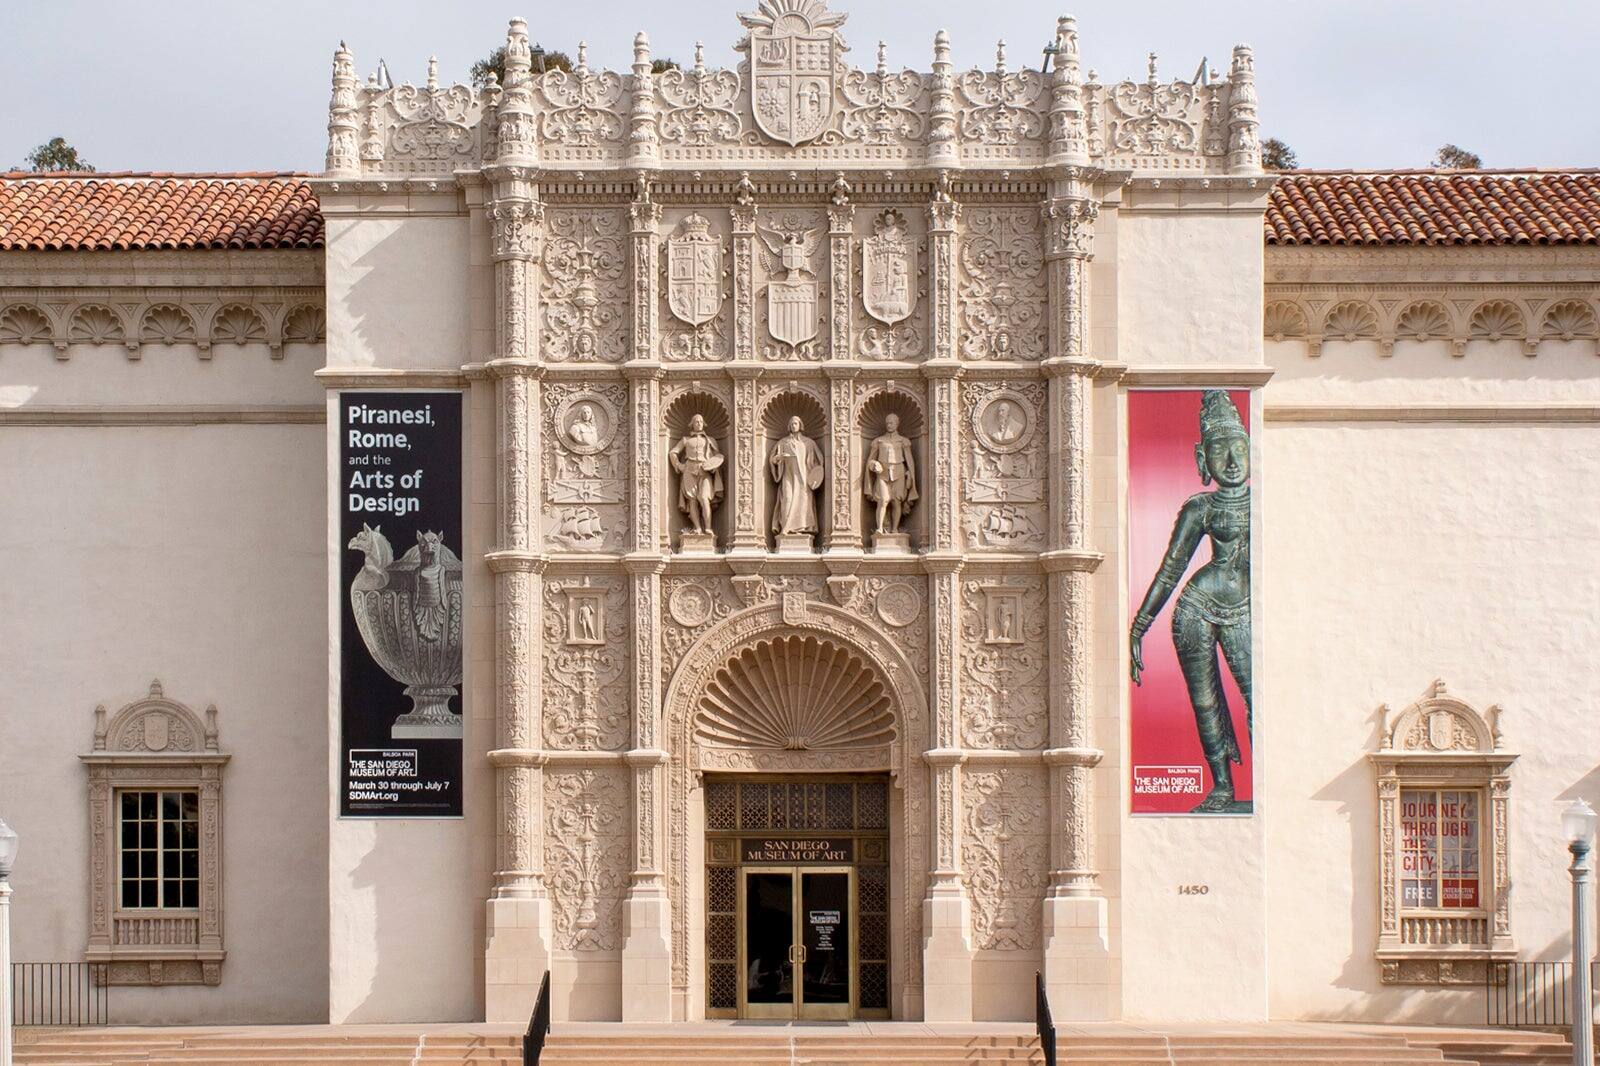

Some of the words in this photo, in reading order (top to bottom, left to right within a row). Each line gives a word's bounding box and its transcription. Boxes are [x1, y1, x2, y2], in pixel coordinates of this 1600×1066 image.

[349, 404, 435, 427] Piranesi,
[349, 429, 412, 450] Rome,
[349, 455, 369, 465] and
[373, 455, 391, 465] the
[349, 470, 395, 489] Arts
[400, 469, 423, 489] of
[349, 492, 420, 516] Design
[350, 760, 366, 769] THE
[367, 760, 384, 769] SAN
[385, 760, 411, 769] DIEGO
[349, 768, 385, 777] MUSEUM
[386, 768, 397, 777] OF
[398, 768, 414, 777] ART
[349, 781, 376, 790] March
[378, 781, 389, 790] 30
[391, 781, 423, 791] through
[424, 781, 442, 792] July
[443, 781, 450, 790] 7
[1135, 777, 1151, 785] THE
[1152, 777, 1170, 785] SAN
[1170, 777, 1196, 785] DIEGO
[1134, 785, 1171, 793] MUSEUM
[1171, 785, 1182, 793] OF
[1182, 785, 1200, 793] ART
[349, 791, 399, 801] SDMArt.org
[1401, 803, 1467, 818] JOURNEY
[1402, 822, 1469, 836] THROUGH
[764, 840, 789, 850] SAN
[791, 840, 830, 850] DIEGO
[1402, 839, 1428, 853] THE
[748, 851, 800, 860] MUSEUM
[802, 851, 820, 860] OF
[821, 851, 847, 860] ART
[1403, 856, 1434, 871] CITY
[1177, 885, 1209, 895] 1450
[1405, 887, 1433, 900] FREE
